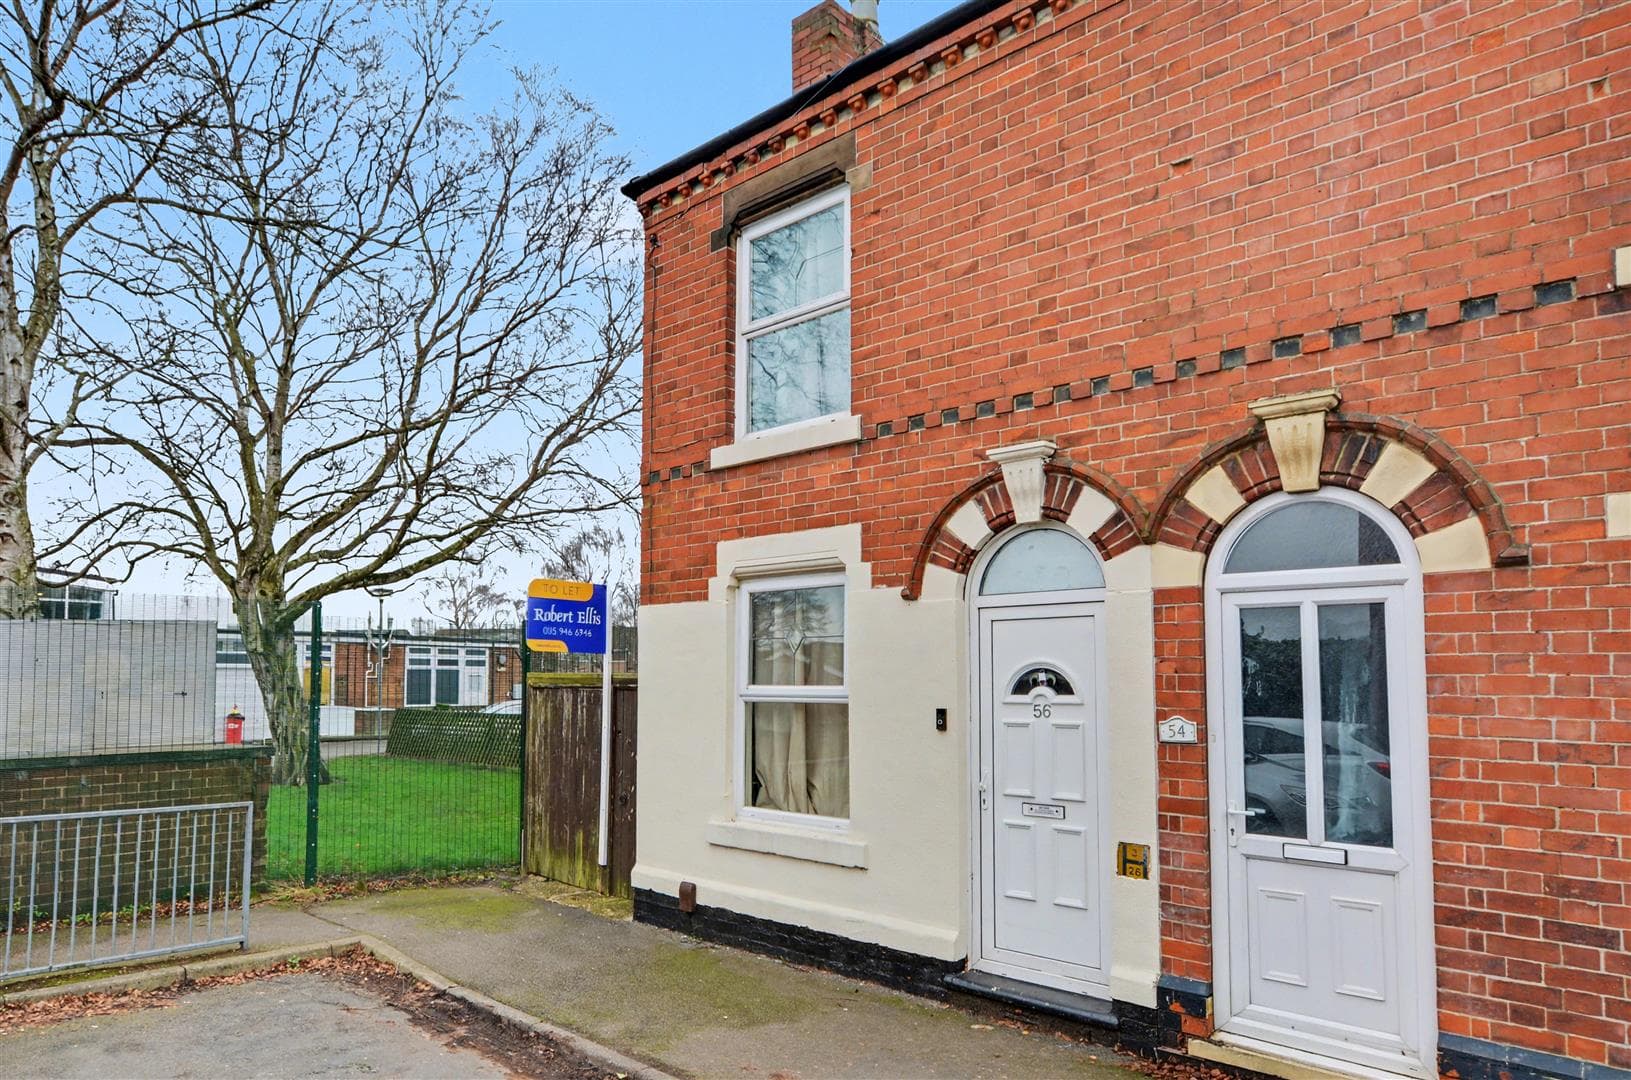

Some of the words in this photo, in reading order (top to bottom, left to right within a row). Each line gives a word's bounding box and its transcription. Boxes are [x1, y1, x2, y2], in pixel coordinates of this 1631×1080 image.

[543, 583, 559, 594] TO
[562, 585, 583, 596] LET
[533, 603, 574, 623] Robert
[577, 606, 601, 626] Ellis
[558, 627, 573, 636] 946
[1033, 703, 1052, 719] 56
[1168, 724, 1186, 738] 54
[1128, 866, 1142, 877] 26
